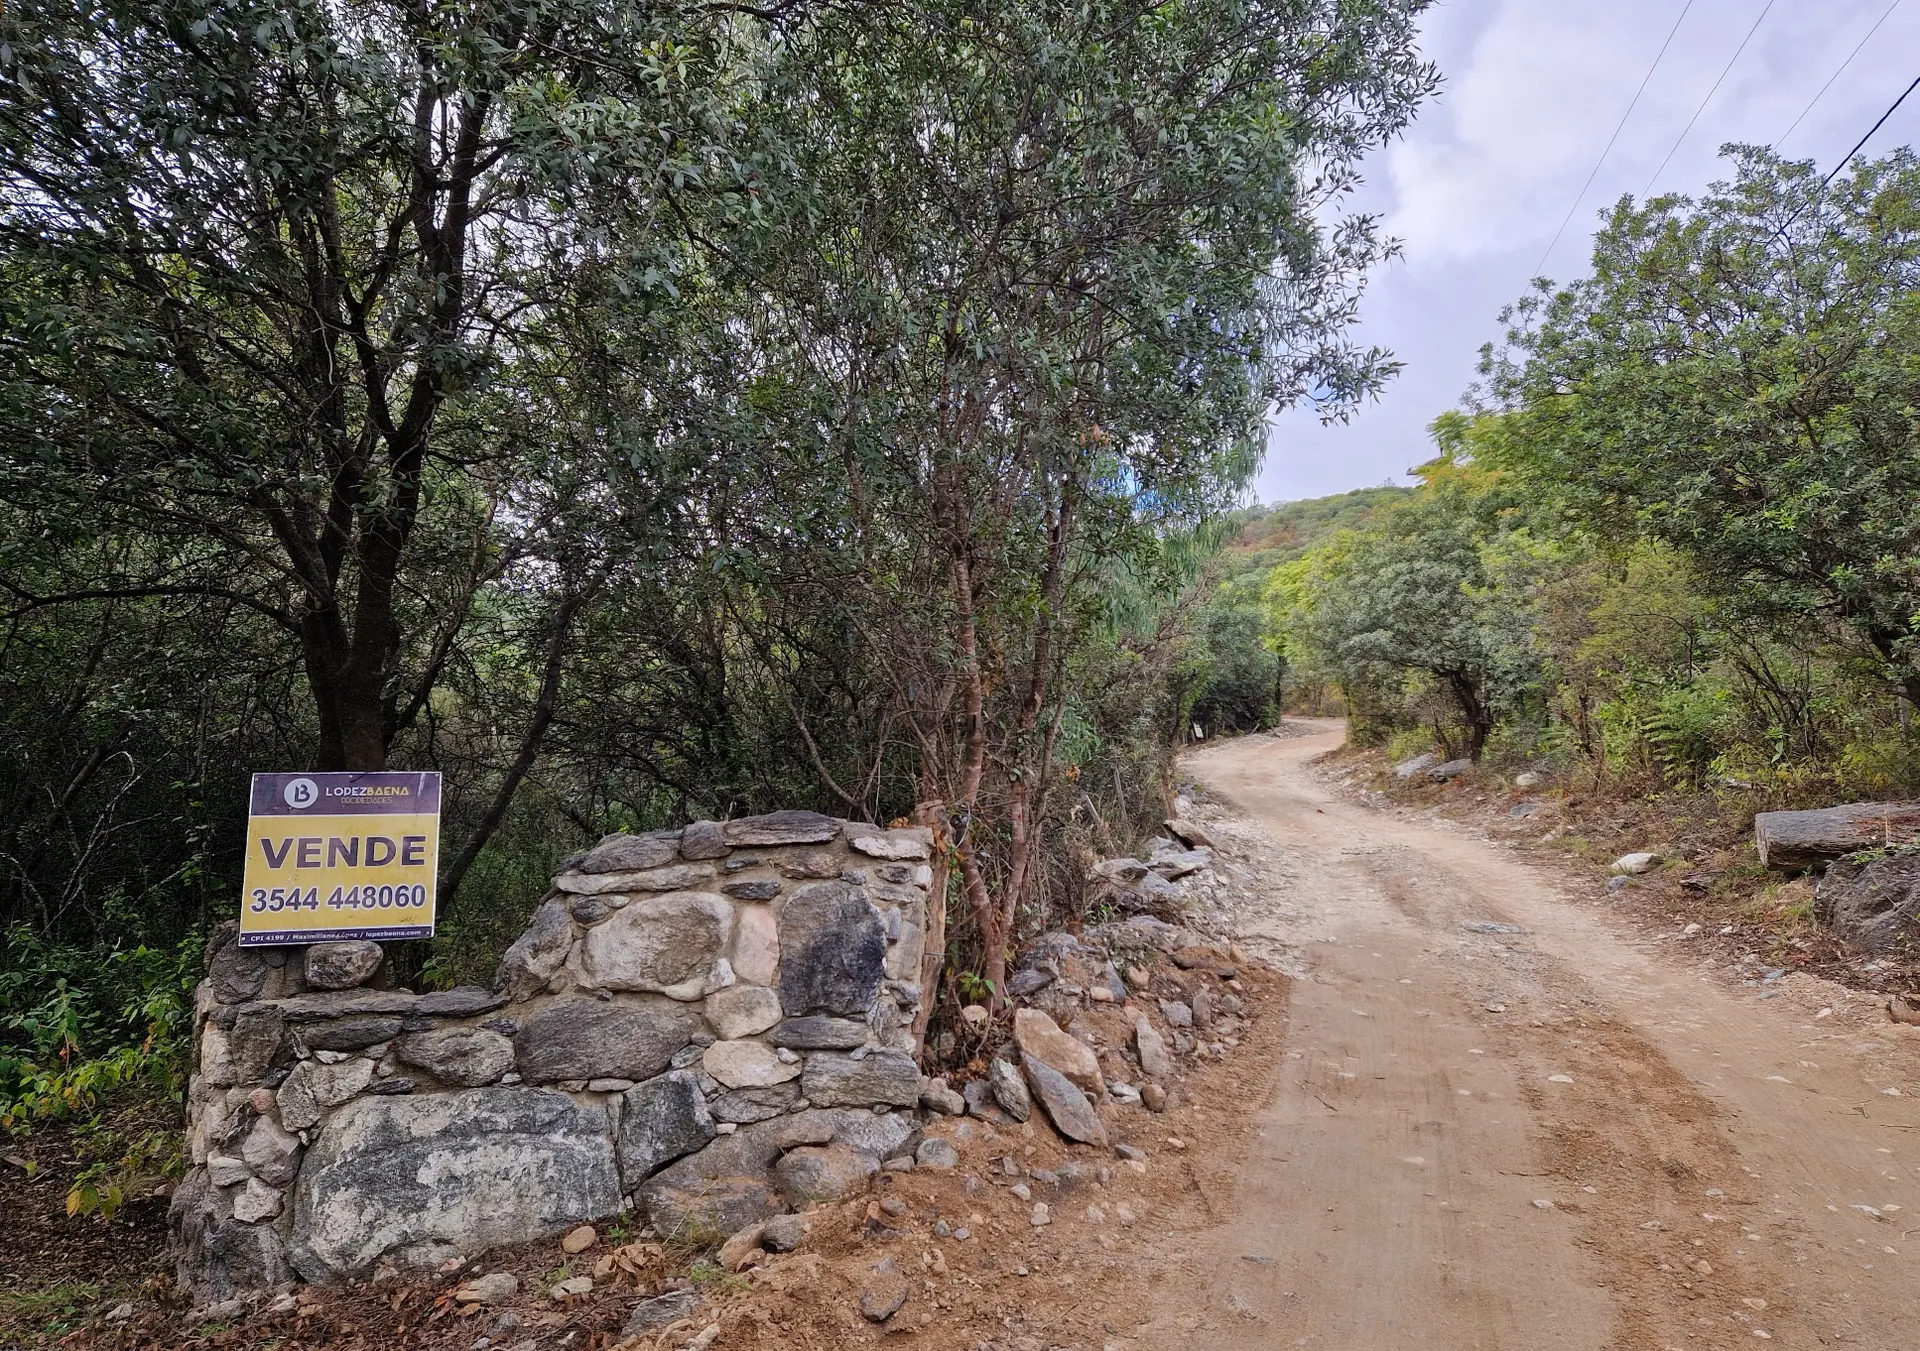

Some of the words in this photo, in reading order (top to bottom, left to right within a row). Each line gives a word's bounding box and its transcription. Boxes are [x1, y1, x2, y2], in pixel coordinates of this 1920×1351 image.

[325, 787, 410, 797] LOPEZBAENA
[260, 835, 427, 869] VENDE
[251, 887, 319, 913] 3544
[327, 884, 426, 910] 448060
[365, 930, 421, 938] lopezbaena.com
